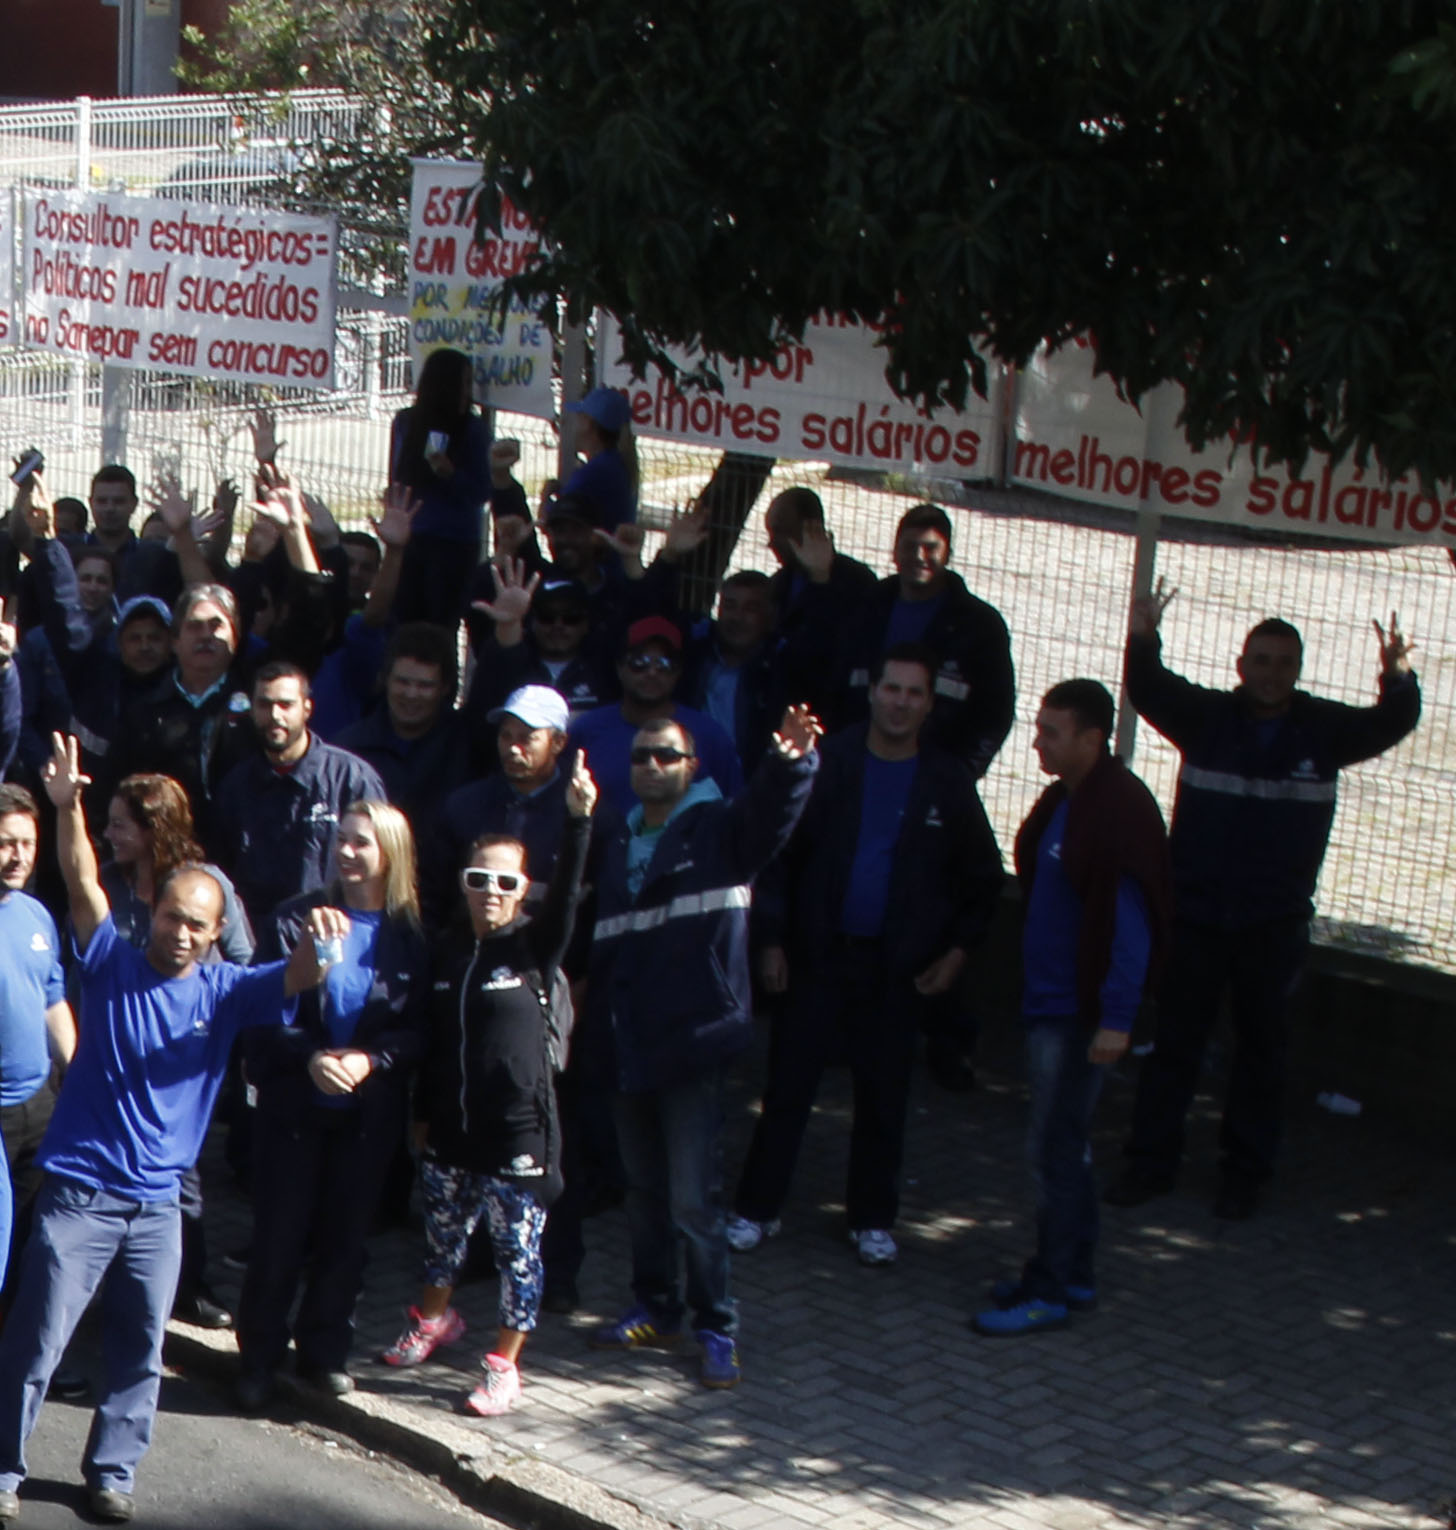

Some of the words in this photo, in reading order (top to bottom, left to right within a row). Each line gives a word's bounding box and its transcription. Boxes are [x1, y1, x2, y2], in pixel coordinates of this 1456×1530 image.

[34, 199, 140, 249] Consultor
[414, 236, 456, 275] EM
[125, 261, 171, 310] mal
[176, 271, 320, 325] sucedidos
[414, 281, 449, 312] POR
[54, 308, 140, 360] Sanepar
[147, 331, 199, 367] sem
[207, 338, 331, 380] concurso
[520, 323, 542, 346] DE
[801, 402, 981, 467] salários
[1014, 434, 1224, 507] melhores
